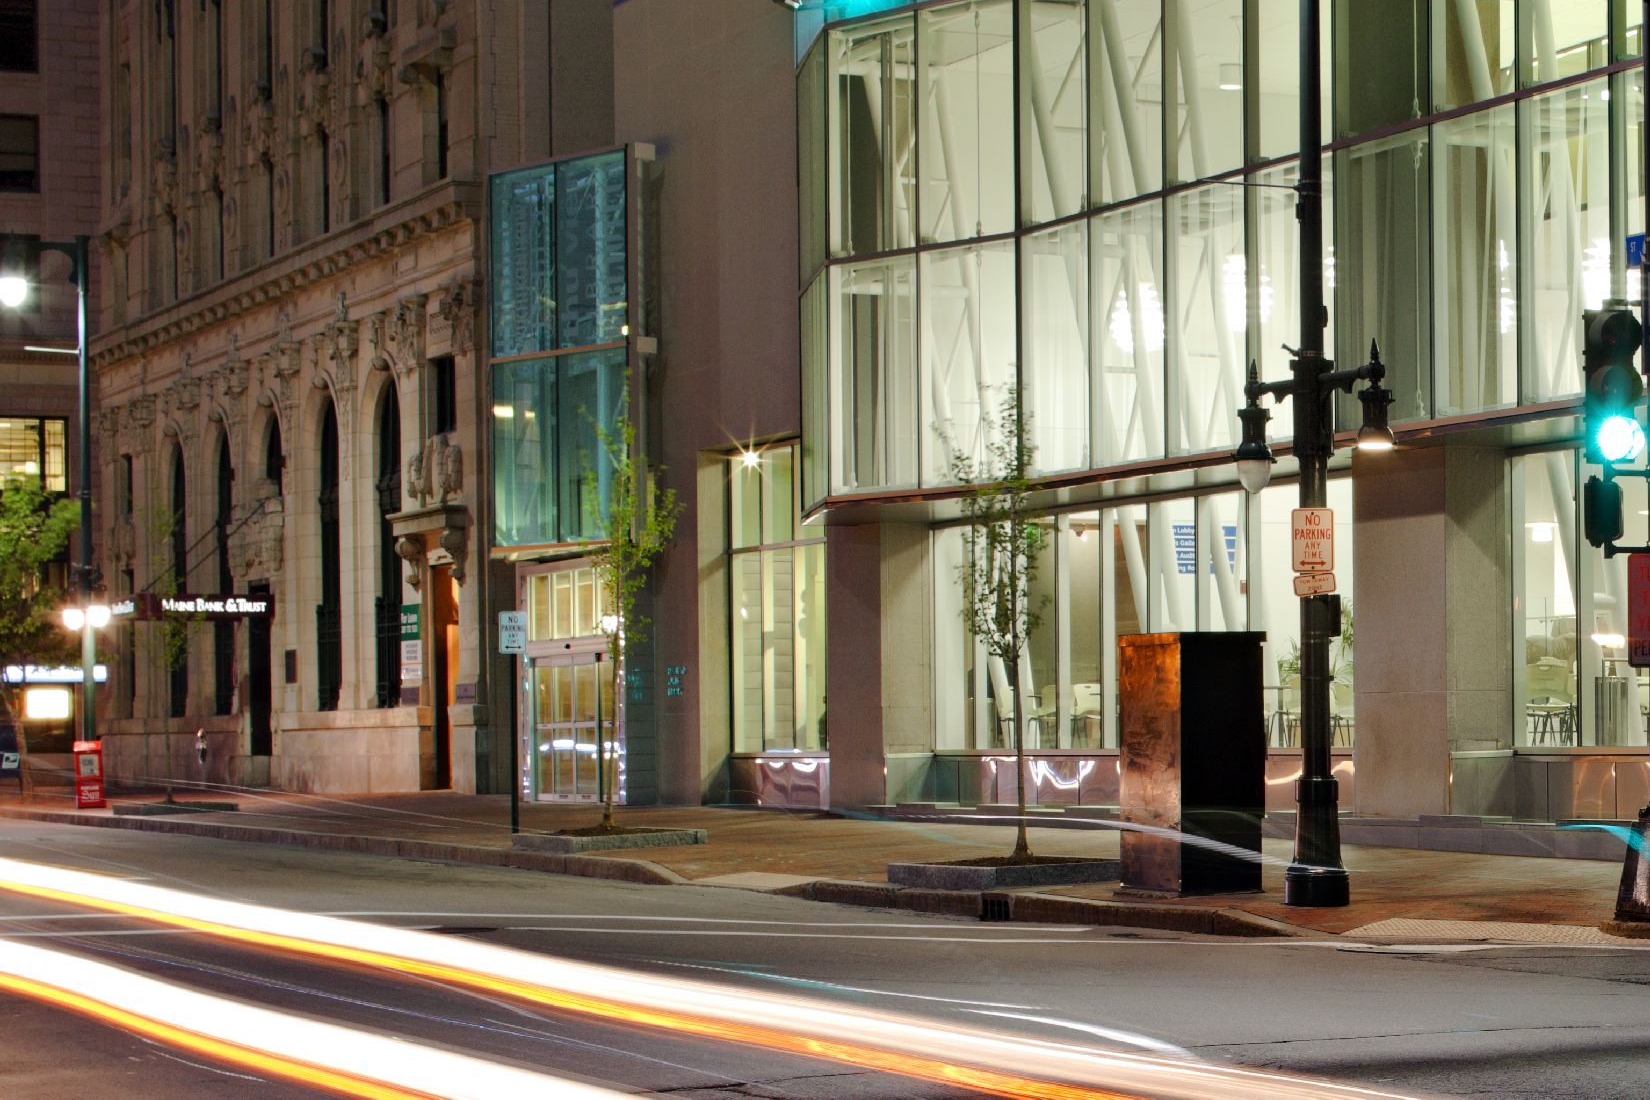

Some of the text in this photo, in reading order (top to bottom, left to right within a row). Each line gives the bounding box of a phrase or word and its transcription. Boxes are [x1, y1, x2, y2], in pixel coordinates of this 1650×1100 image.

[1305, 514, 1321, 526] NO
[1294, 528, 1331, 540] PARKING
[1304, 541, 1321, 550] ANY
[1303, 551, 1323, 560] TIME
[195, 598, 225, 613] BANK
